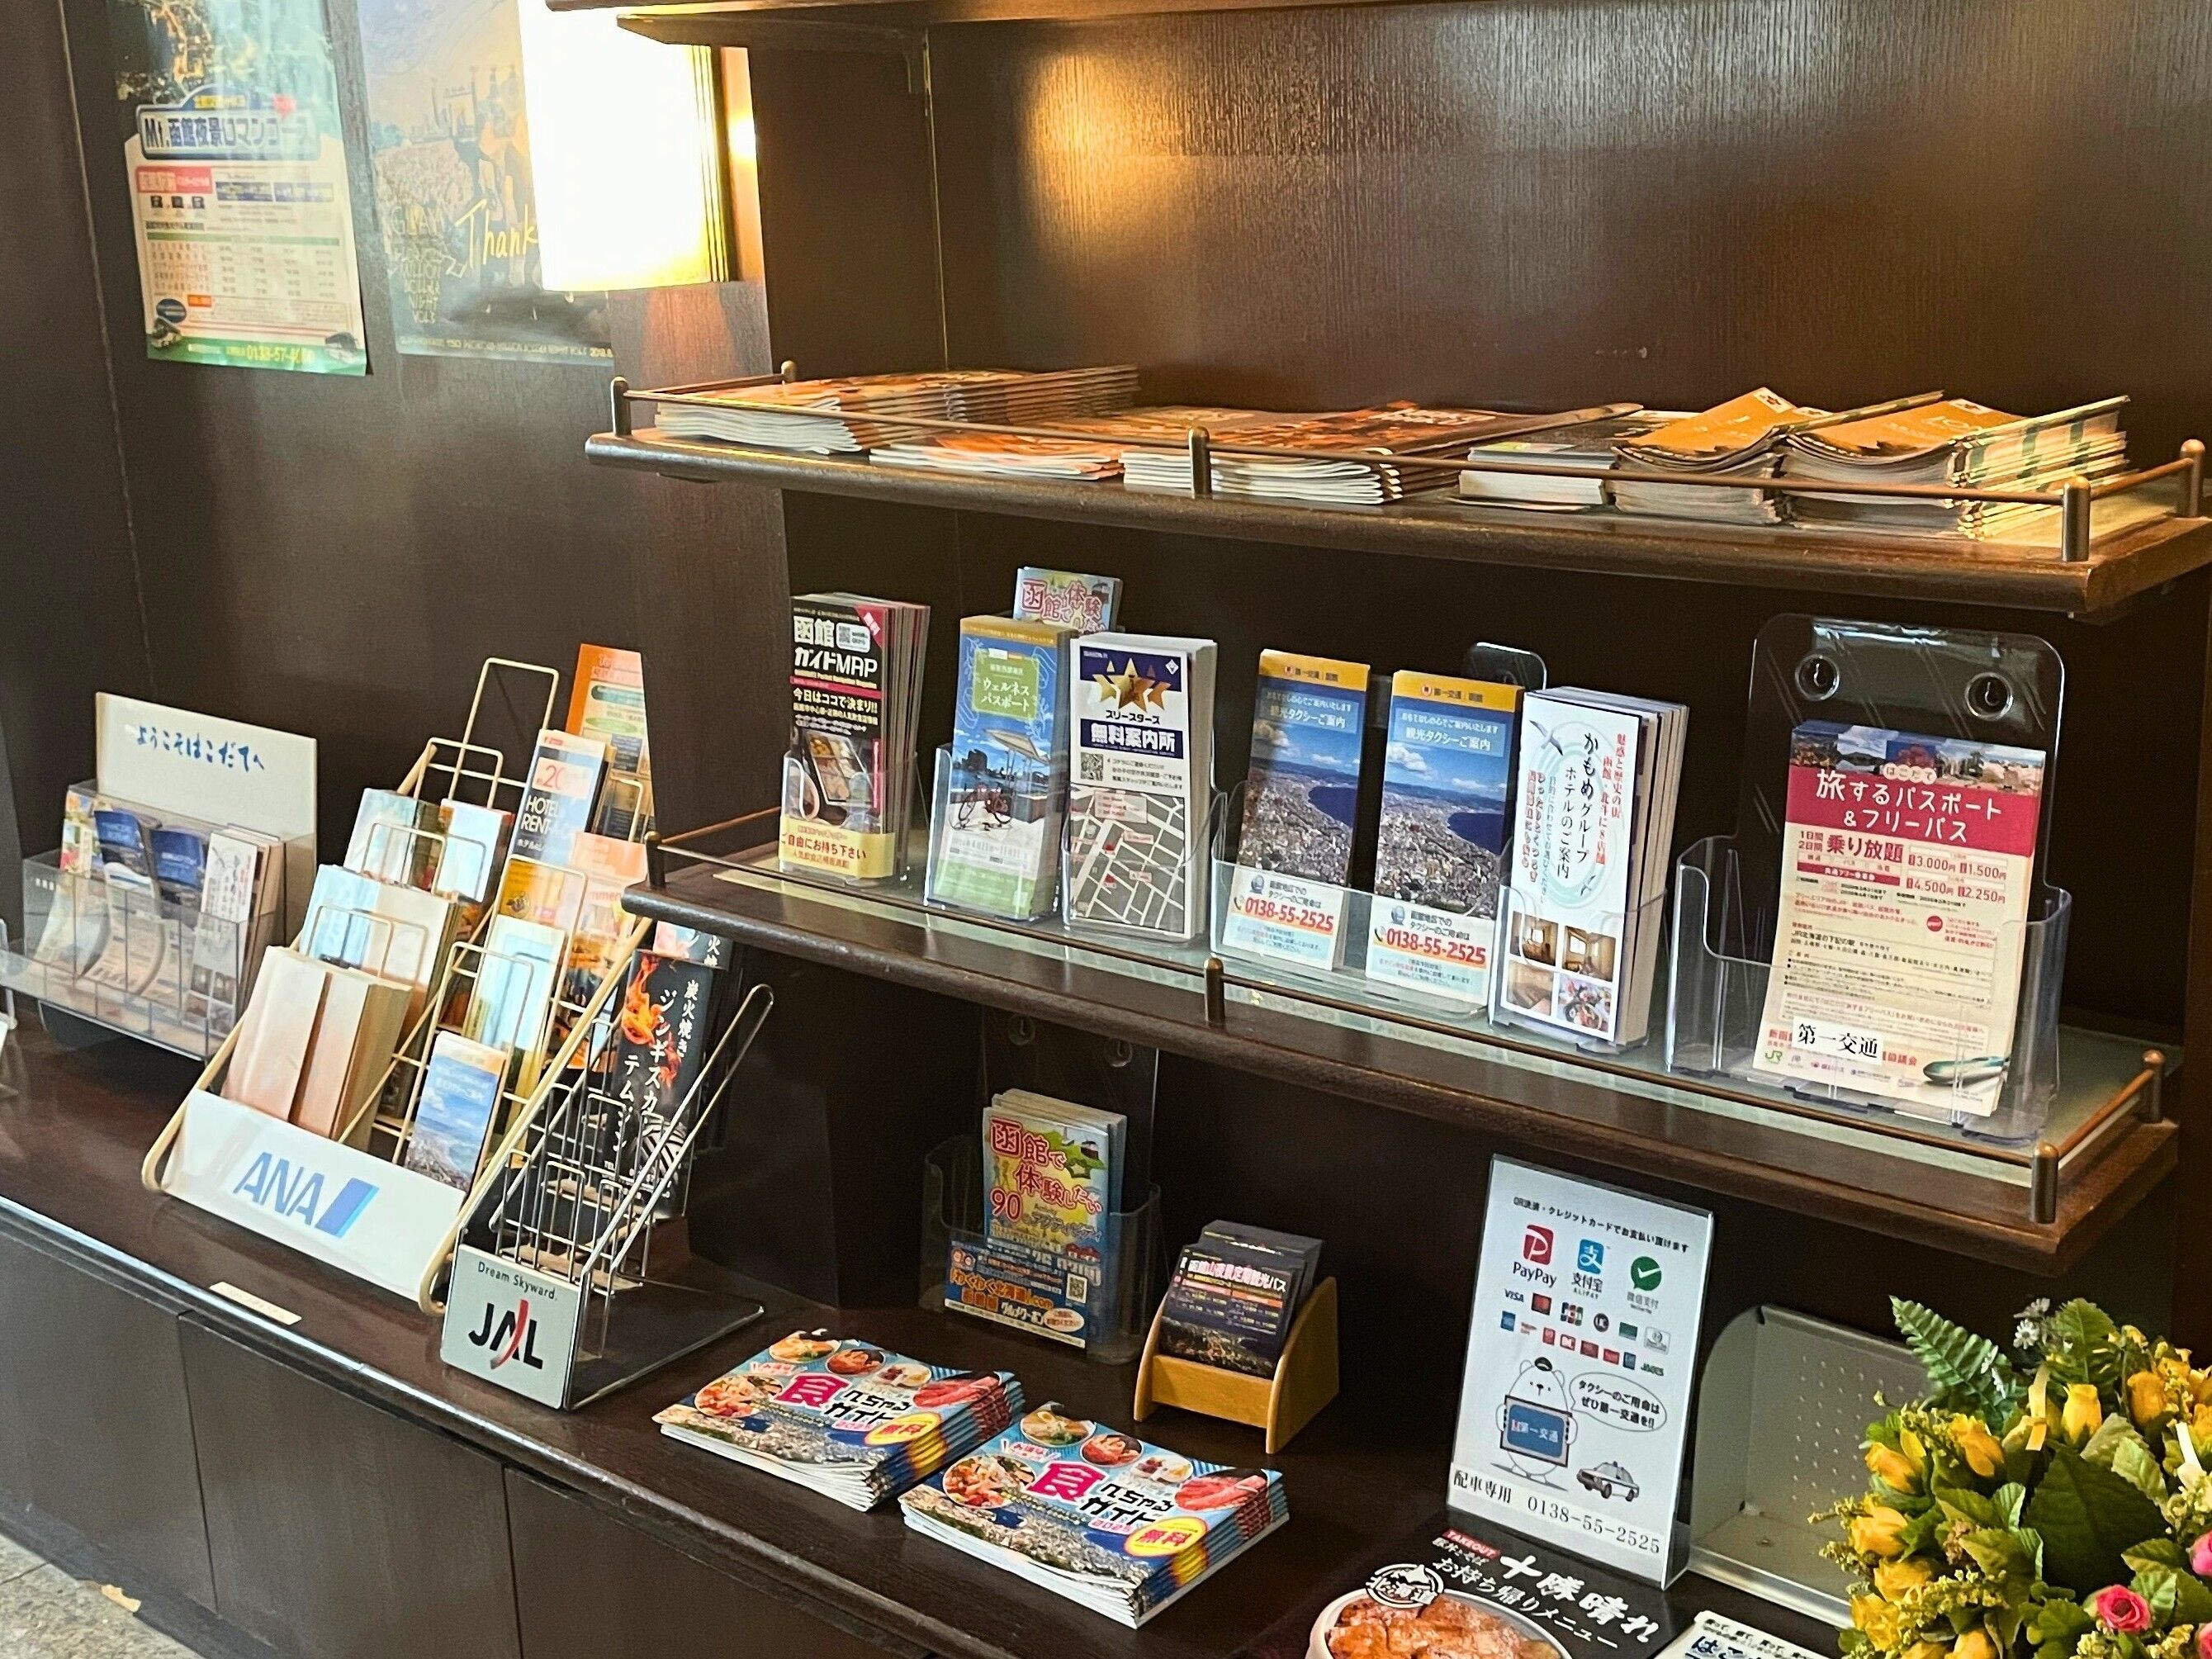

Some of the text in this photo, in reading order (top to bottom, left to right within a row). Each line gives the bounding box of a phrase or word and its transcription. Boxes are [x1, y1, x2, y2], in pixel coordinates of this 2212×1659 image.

[793, 615, 835, 648] 函館
[794, 647, 878, 678] ガイドMAP
[981, 692, 1030, 712] パスポート
[983, 676, 1030, 696] ウェルネス
[1106, 709, 1161, 725] スリースターズ
[135, 724, 266, 772] ようこそはこだてへ
[1091, 722, 1176, 752] 無料案内所
[1405, 727, 1491, 751] 観光タクシーご案内
[1575, 732, 1599, 864] かもめグループ
[1816, 769, 2002, 821] 旅するパスポート
[1556, 766, 1578, 879] ホテルのご案内
[1843, 808, 1968, 844] &フリーバス
[1826, 834, 1904, 864] 乗り放題
[1244, 897, 1334, 932] 0138-55-2525
[1386, 927, 1487, 965] 0138-55-2525
[676, 979, 699, 1058] 炭火焼き
[1798, 1023, 1878, 1059] 第一交通
[991, 1116, 1068, 1171] 函館で
[232, 1151, 324, 1226] ANA
[477, 1261, 510, 1282] Dream
[1512, 1261, 1557, 1289] PayPay
[1570, 1272, 1603, 1293] 支付宝
[1504, 1288, 1525, 1303] VISA
[467, 1298, 544, 1371] JAL
[776, 1374, 849, 1407] 食
[1578, 1379, 1660, 1415] タクシーのご用命は
[1027, 1462, 1106, 1501] 食
[1452, 1470, 1660, 1554] 配車専用 0138-55-2525
[1136, 1529, 1193, 1547] 無料
[1446, 1529, 1499, 1559] TAKEOUT
[1365, 1575, 1440, 1606] 北海道
[1432, 1557, 1619, 1650] お持ち帰りメニュー
